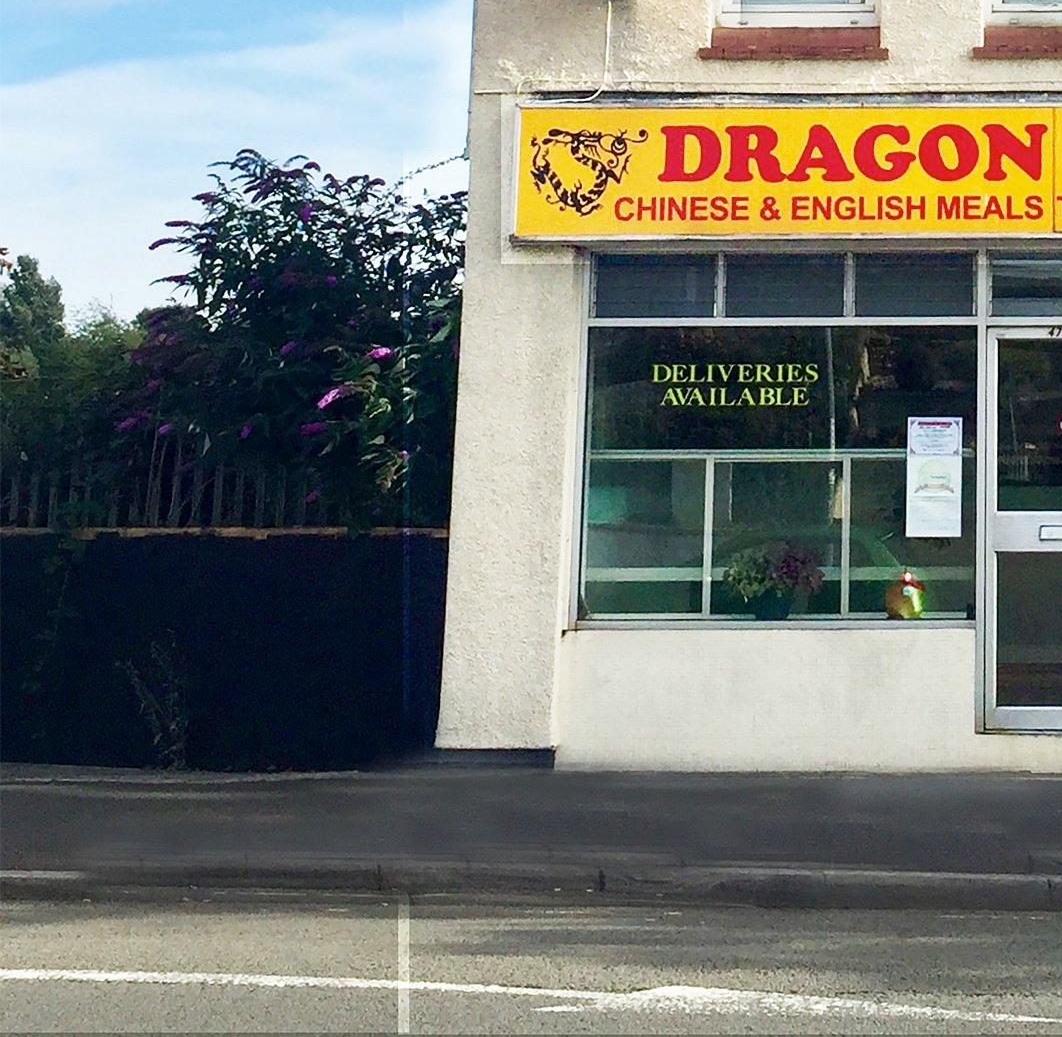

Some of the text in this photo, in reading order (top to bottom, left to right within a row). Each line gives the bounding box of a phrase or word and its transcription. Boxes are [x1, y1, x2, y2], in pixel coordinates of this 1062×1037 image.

[658, 123, 1049, 183] DRAGON
[614, 196, 750, 222] CHINESE
[760, 197, 782, 221] &
[791, 195, 926, 221] ENGLISH
[937, 195, 1044, 220] MEALS
[652, 363, 819, 383] DELIVERIES
[660, 386, 810, 406] AVAILABLE
